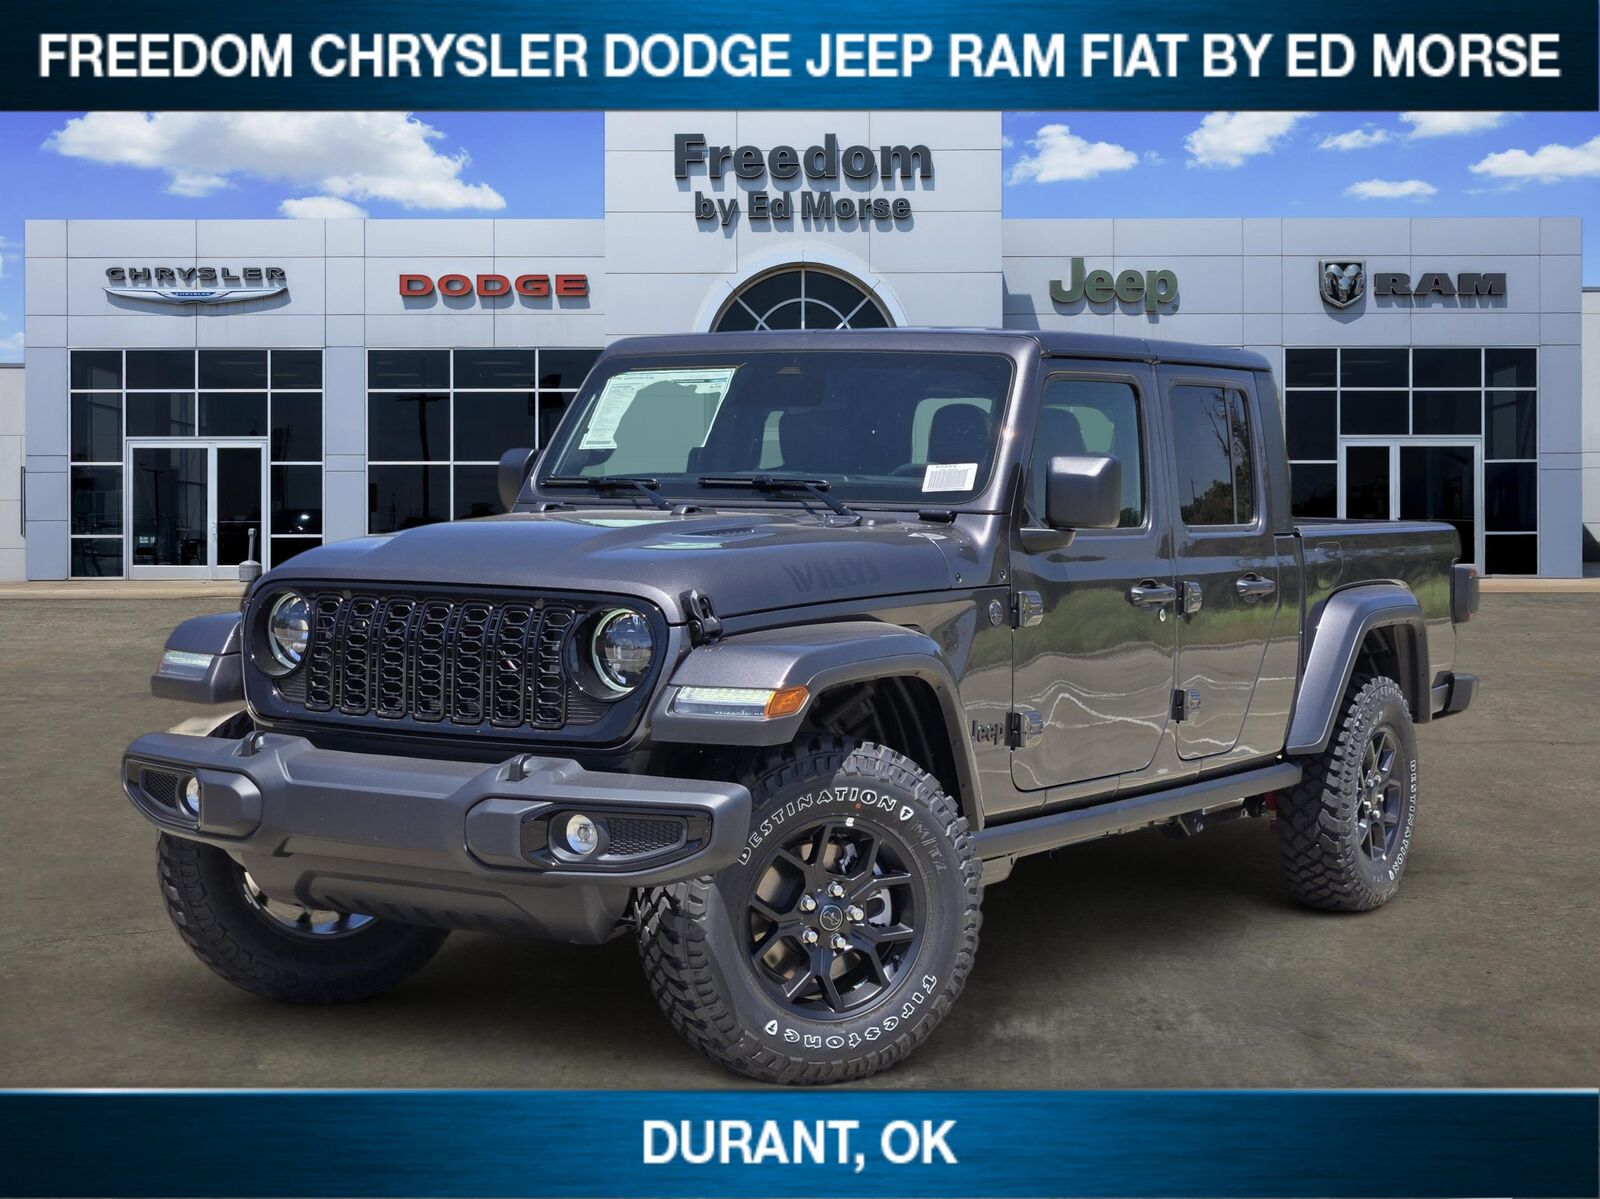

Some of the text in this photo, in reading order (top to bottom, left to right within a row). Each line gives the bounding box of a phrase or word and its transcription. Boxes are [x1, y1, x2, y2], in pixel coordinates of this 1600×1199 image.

[674, 133, 933, 179] Freedom
[694, 191, 912, 225] by Ed Morse
[105, 267, 287, 281] CHRYSLER
[399, 273, 589, 297] DODGE
[1049, 257, 1178, 312] Jeep
[1374, 272, 1507, 296] RAM
[971, 719, 1004, 746] Jeep
[736, 786, 897, 866] DESTINATION
[1392, 758, 1417, 876] DESTINATION
